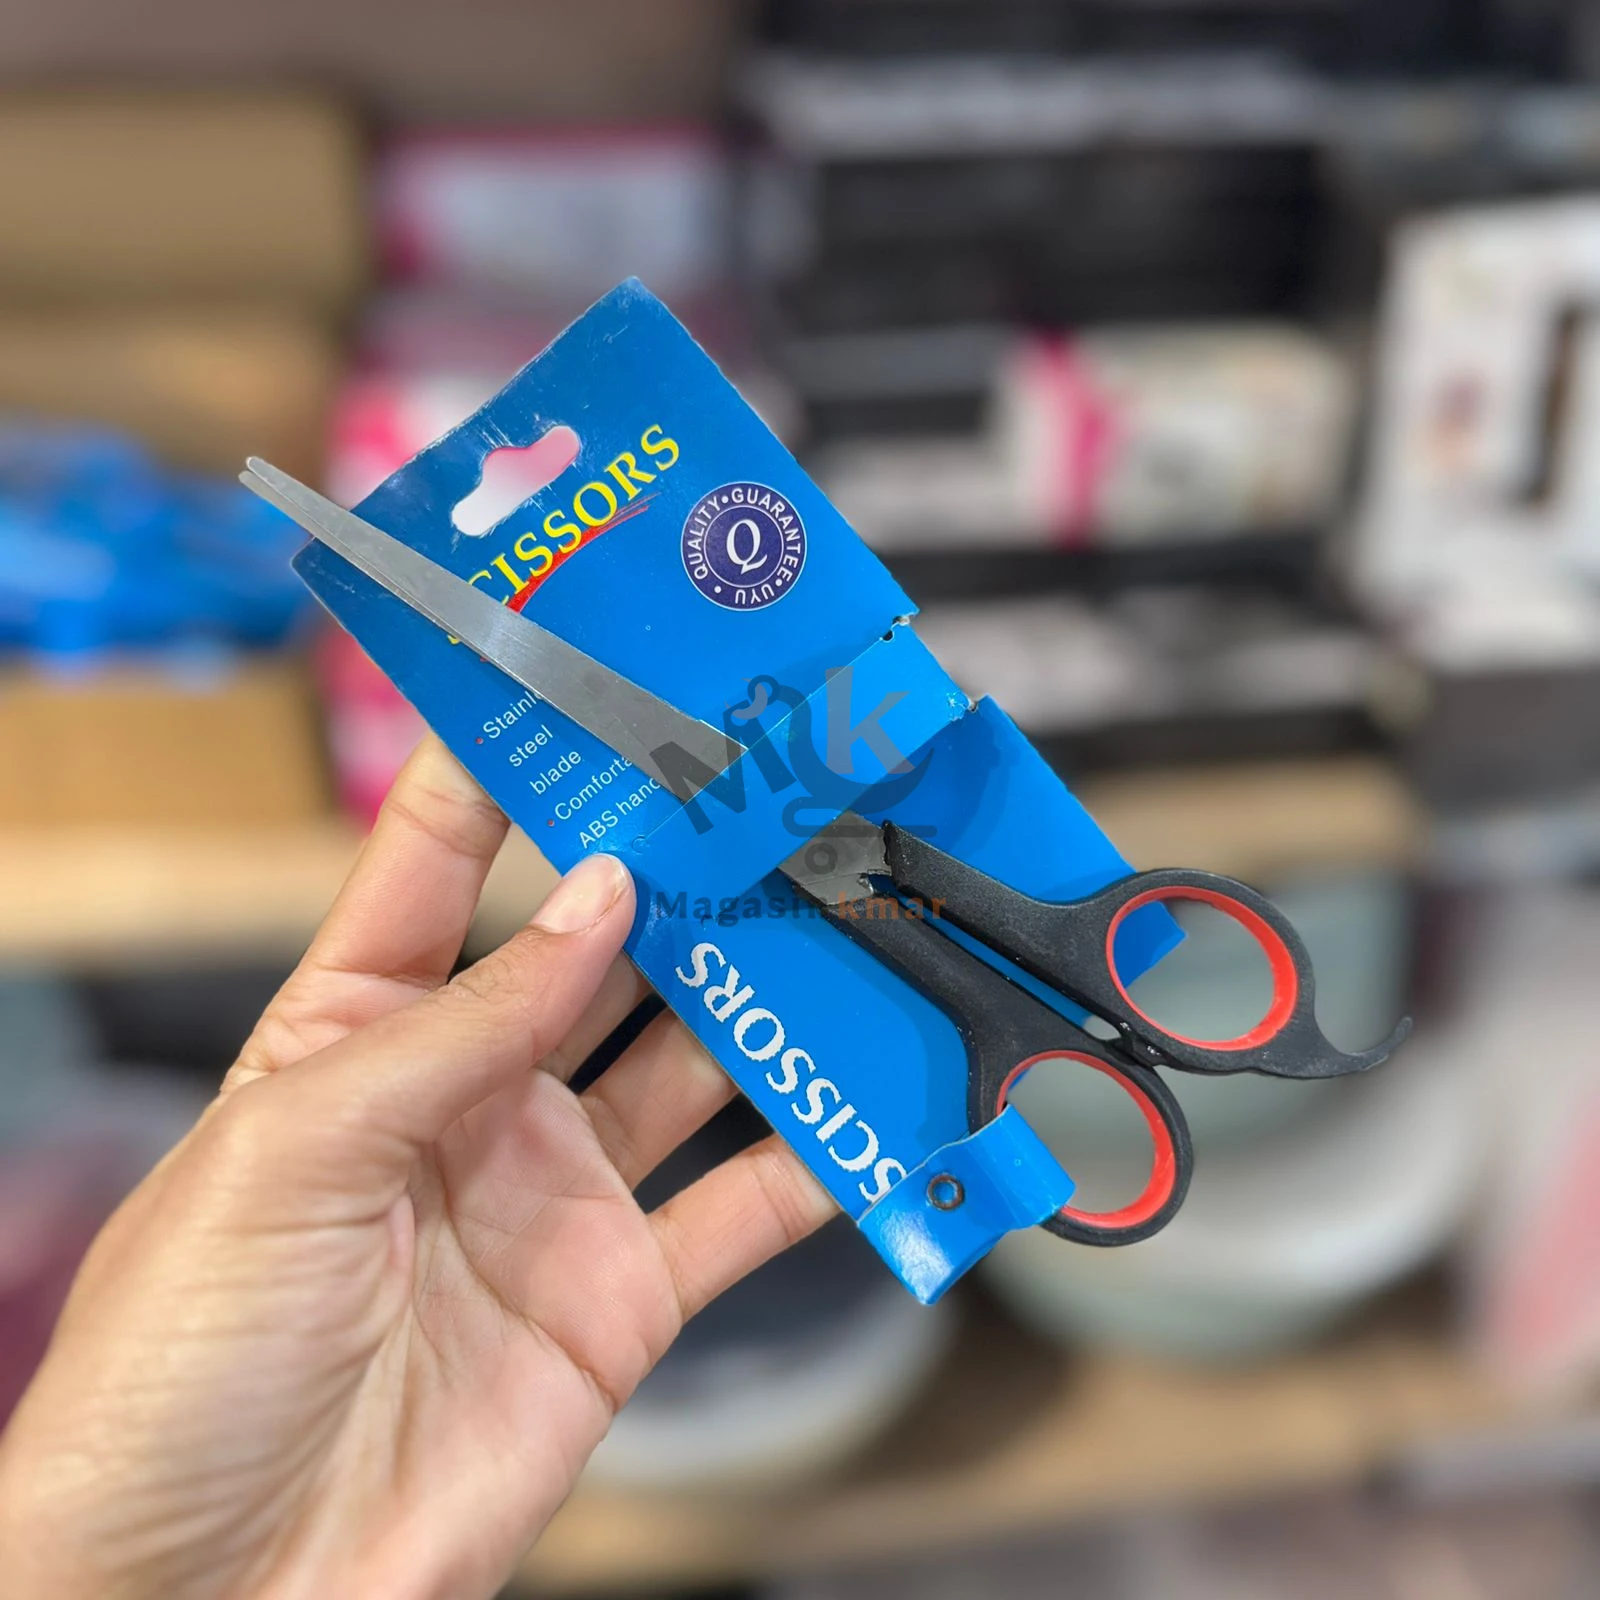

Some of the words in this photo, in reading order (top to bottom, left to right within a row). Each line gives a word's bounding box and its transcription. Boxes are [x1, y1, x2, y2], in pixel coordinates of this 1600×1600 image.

[447, 424, 680, 645] ISSORS
[688, 496, 720, 580] QUALITY
[726, 519, 768, 575] Q
[732, 488, 801, 582] GUARANTEE
[735, 584, 775, 605] UYU
[482, 690, 542, 739] Stainl
[509, 724, 553, 768] steel
[529, 751, 582, 795] blade
[579, 810, 619, 849] ABS
[675, 942, 908, 1203] SCISSORS
